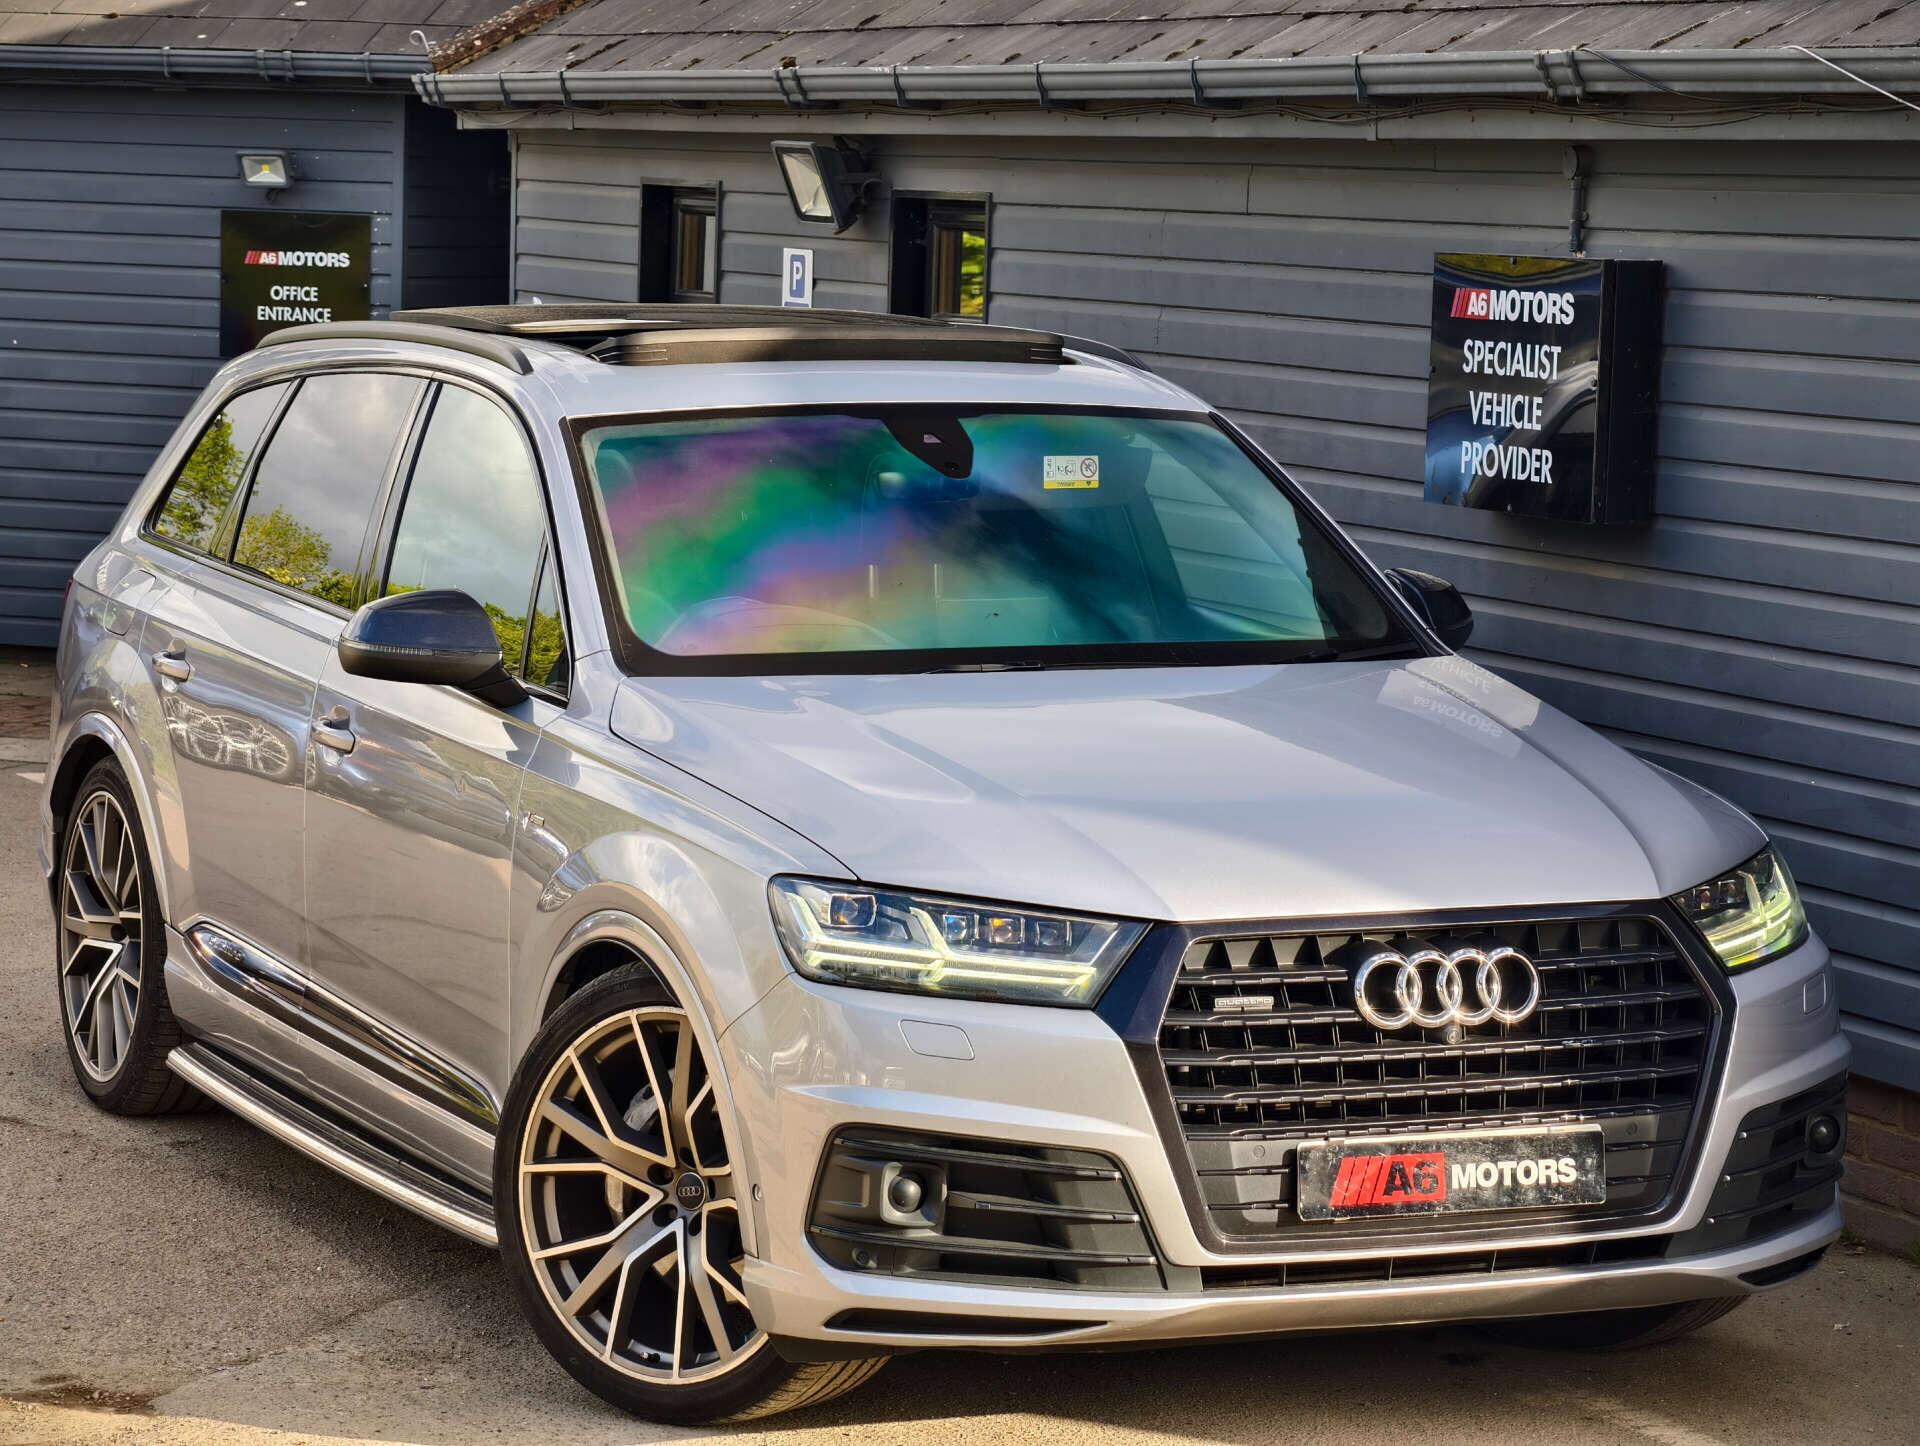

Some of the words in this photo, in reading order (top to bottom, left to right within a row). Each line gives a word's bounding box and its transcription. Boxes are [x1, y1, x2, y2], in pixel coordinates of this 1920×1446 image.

[270, 286, 319, 302] OFFICE
[793, 261, 803, 291] P
[257, 305, 331, 323] ENTRANCE
[1462, 339, 1562, 380] SPECIALIST
[1469, 390, 1543, 431] VEHICLE
[1461, 440, 1553, 484] PROVIDER
[1382, 1160, 1440, 1197] A6
[1452, 1158, 1578, 1189] MOTORS
